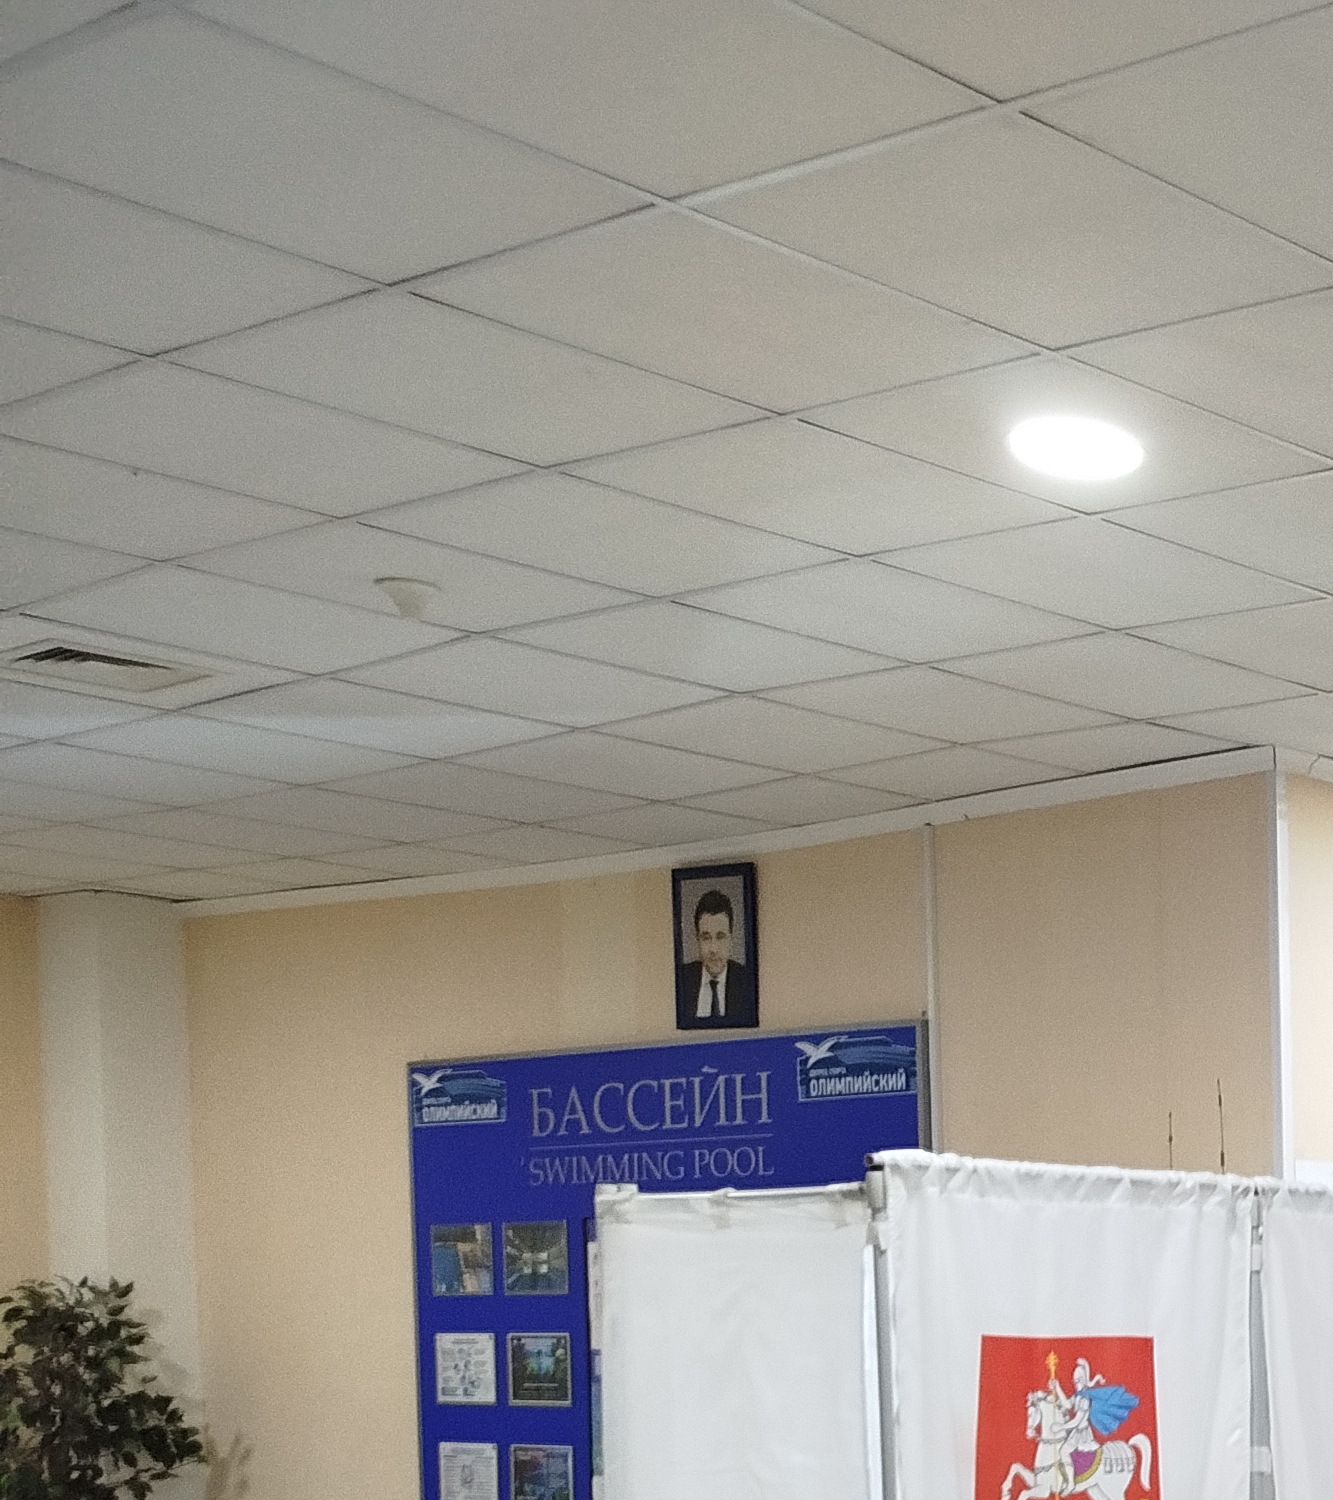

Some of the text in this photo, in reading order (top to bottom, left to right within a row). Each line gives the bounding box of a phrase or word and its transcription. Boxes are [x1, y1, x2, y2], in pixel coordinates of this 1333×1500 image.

[529, 1065, 773, 1137] БАССЕЙН
[810, 1067, 906, 1097] ОЛИМПИЙСКИЙ
[529, 1146, 774, 1186] SWIMMING POOL
